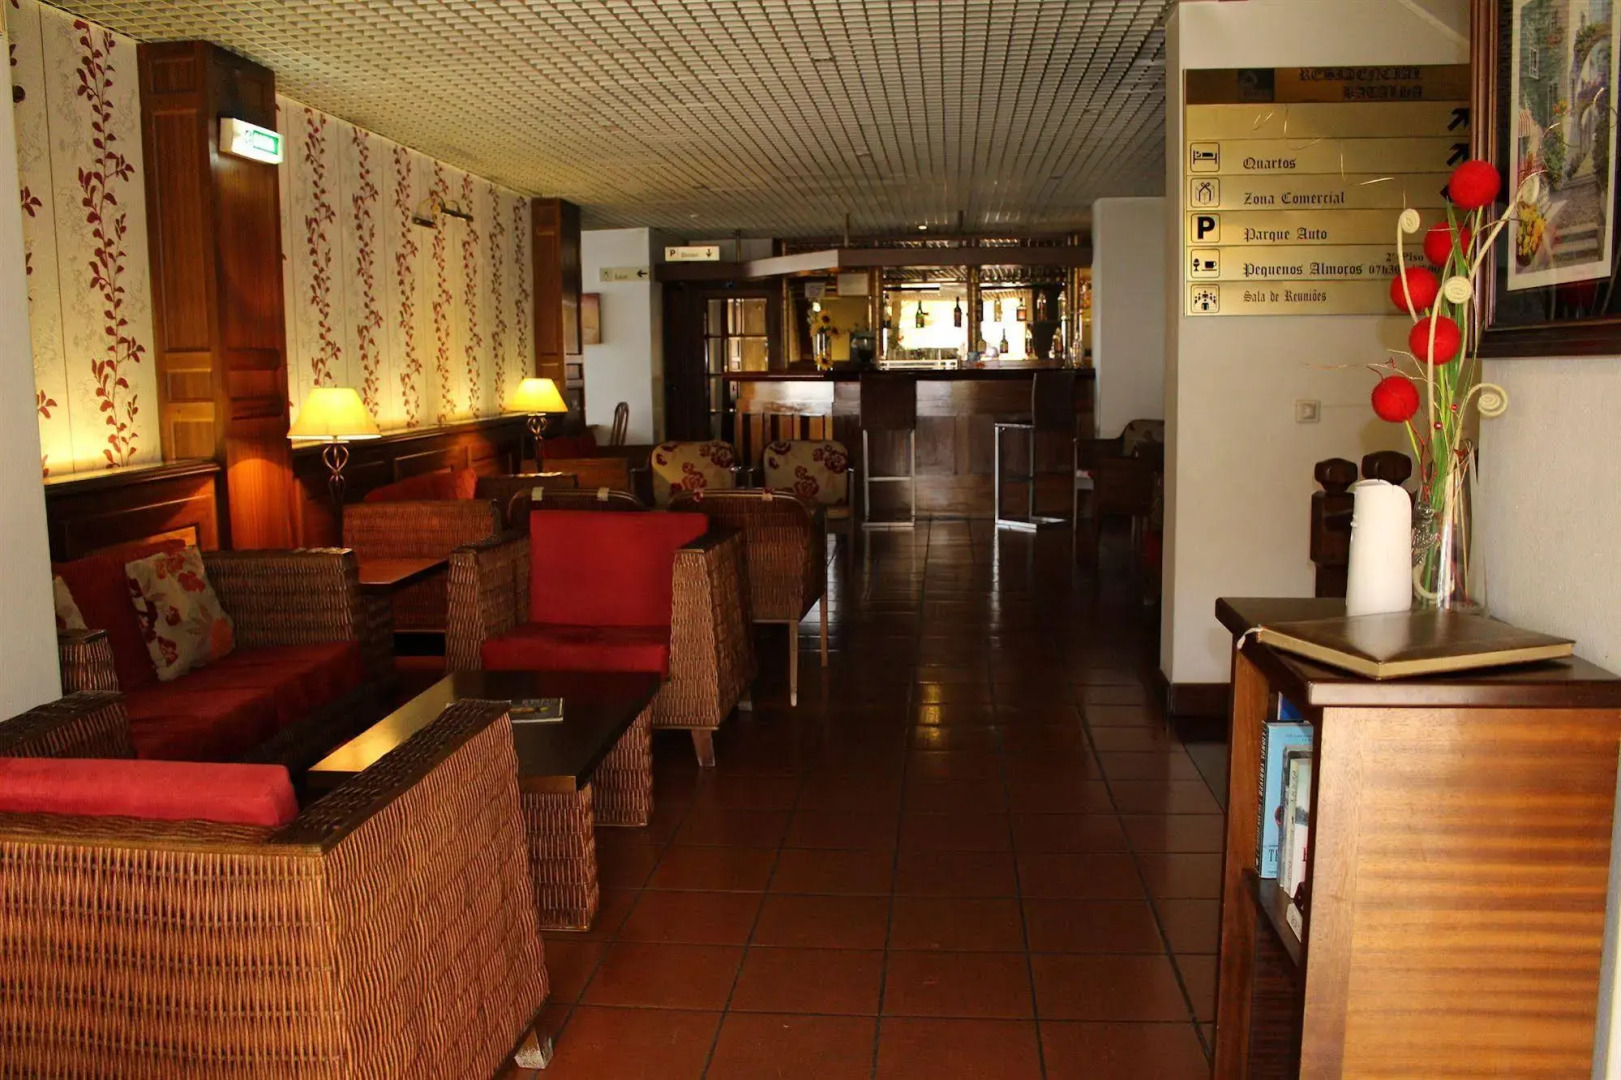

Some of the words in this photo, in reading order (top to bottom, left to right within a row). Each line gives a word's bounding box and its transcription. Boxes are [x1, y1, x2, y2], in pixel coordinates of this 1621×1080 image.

[1243, 156, 1297, 170] Quartos
[1243, 192, 1275, 205] Zona
[1281, 191, 1345, 205] Comercial
[1197, 216, 1216, 240] P
[1243, 227, 1290, 242] Parque
[1297, 227, 1327, 240] Auto
[1243, 262, 1303, 277] Pequenos
[1243, 290, 1266, 303] Sala
[1270, 290, 1280, 302] de
[1284, 289, 1327, 303] Reuniões
